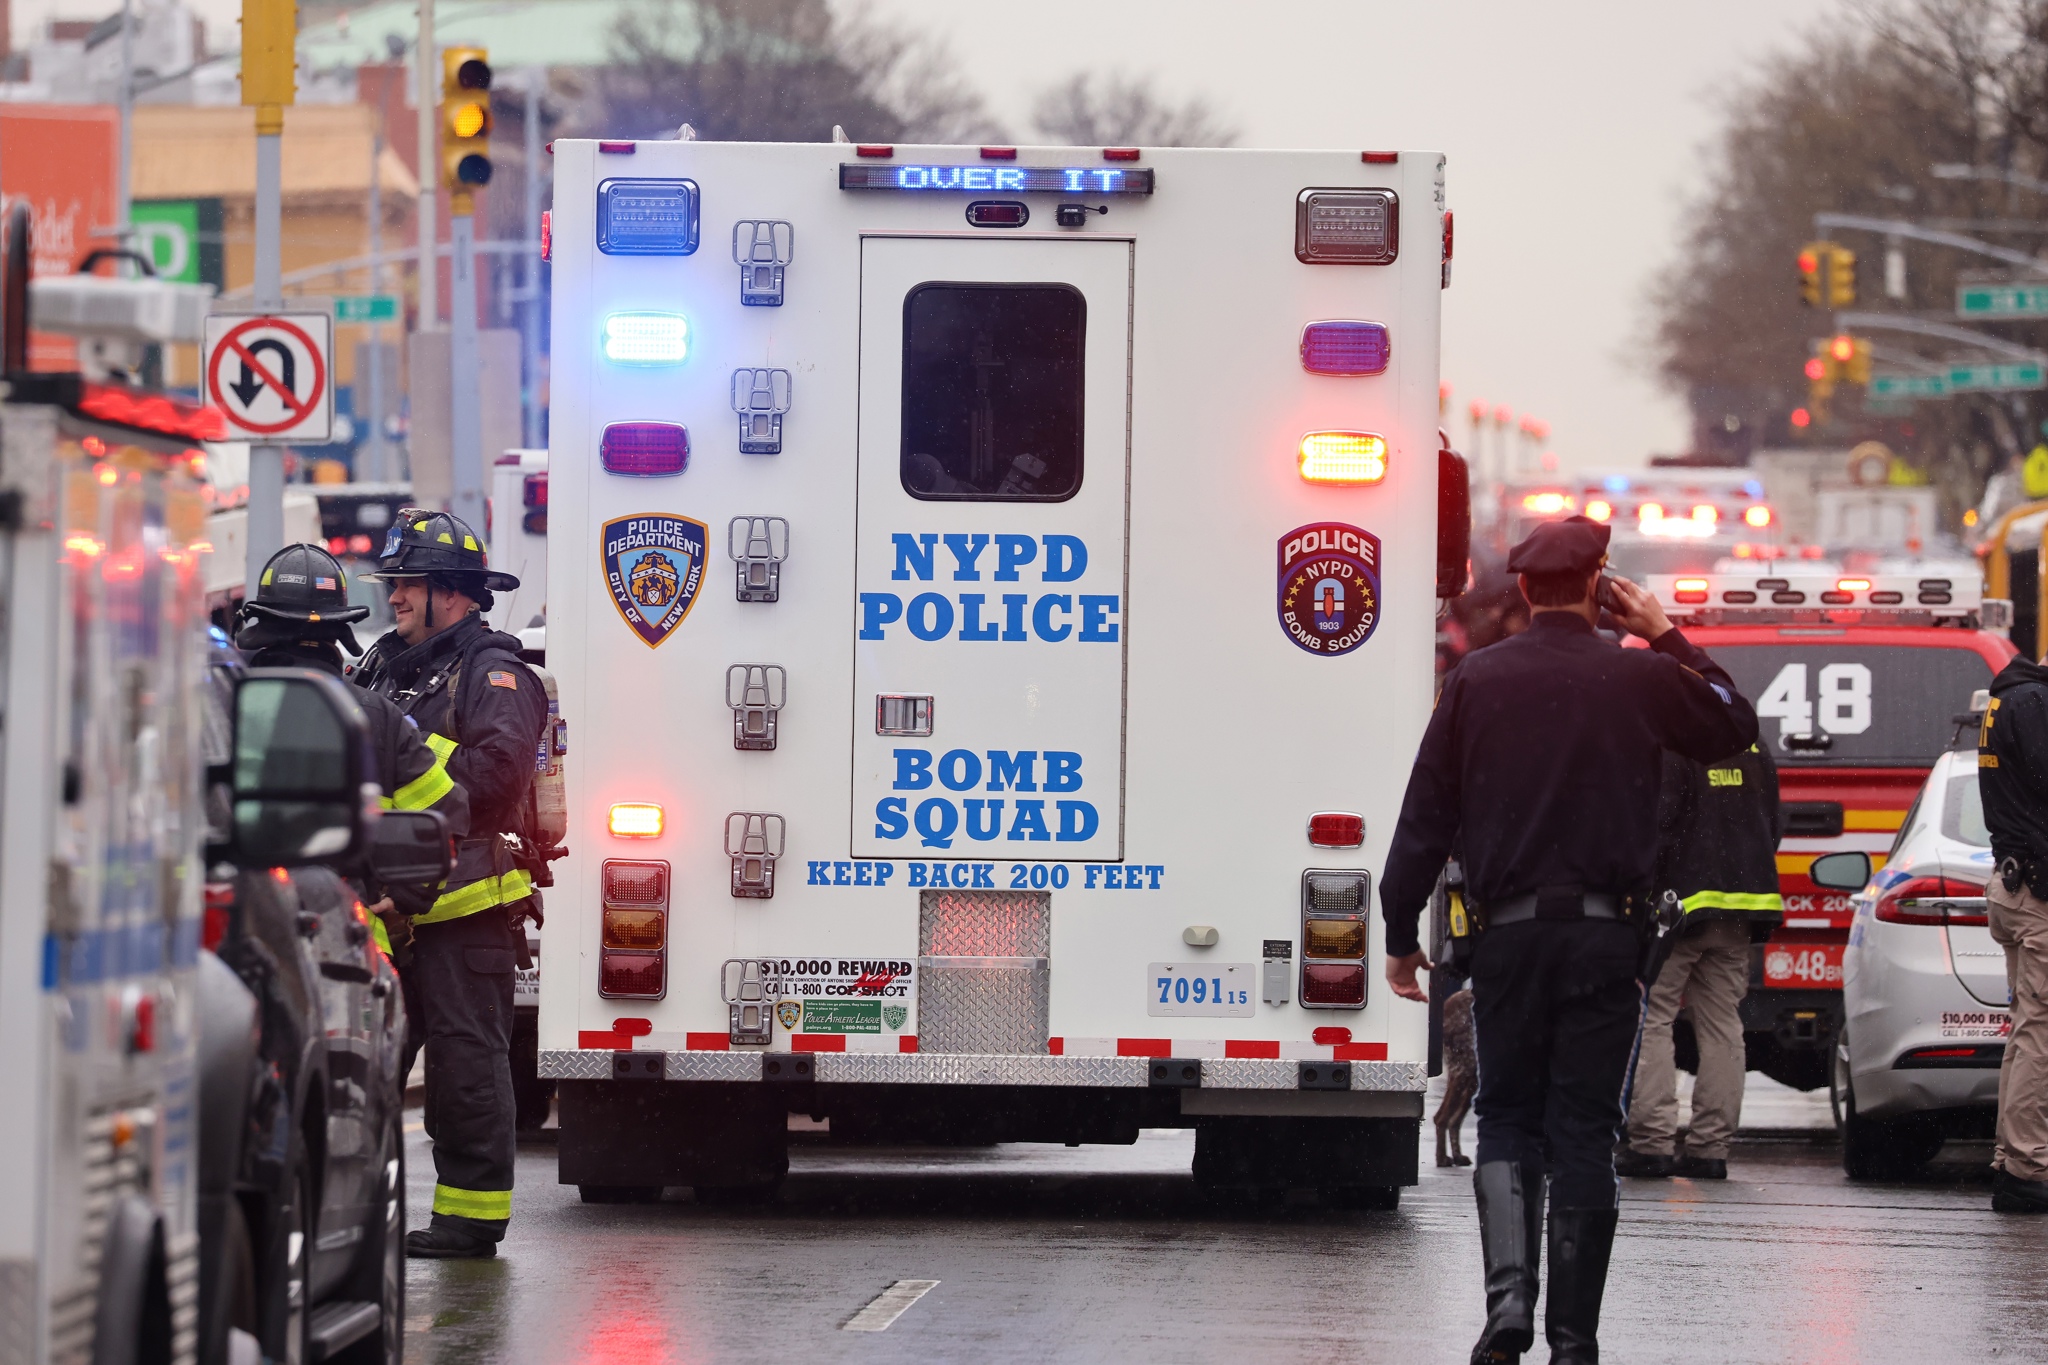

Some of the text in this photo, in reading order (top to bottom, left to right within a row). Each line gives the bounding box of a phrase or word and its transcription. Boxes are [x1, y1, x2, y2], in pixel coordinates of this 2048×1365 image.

[899, 166, 1121, 191] OVER IT
[628, 519, 684, 536] POLICE
[608, 532, 702, 558] DEPARTMENT
[891, 533, 1088, 582] NYPD
[1284, 529, 1375, 566] POLICE
[1305, 560, 1354, 580] NYPD
[609, 571, 642, 624] CITY OF
[661, 565, 702, 631] NEW YORK
[859, 591, 1119, 643] POLICE
[1283, 610, 1374, 652] BOMB SQUAD
[1318, 621, 1340, 631] 1903
[1756, 662, 1873, 735] 48
[892, 748, 1083, 793] BOMB
[875, 796, 1099, 849] SQUAD
[807, 861, 1165, 890] KEEP BACK 200 FEET
[1783, 895, 1851, 912] CK 20
[761, 960, 912, 976] $10,000 REWARD
[1794, 949, 1826, 982] 48
[765, 983, 790, 995] CAL
[793, 983, 822, 995] 1-800
[1157, 977, 1248, 1005] 7091 15
[804, 1011, 825, 1023] POLICE
[825, 1012, 855, 1023] ATHLETIC
[855, 1012, 880, 1024] LEAGUE
[1942, 1013, 2012, 1025] $10,000 REW
